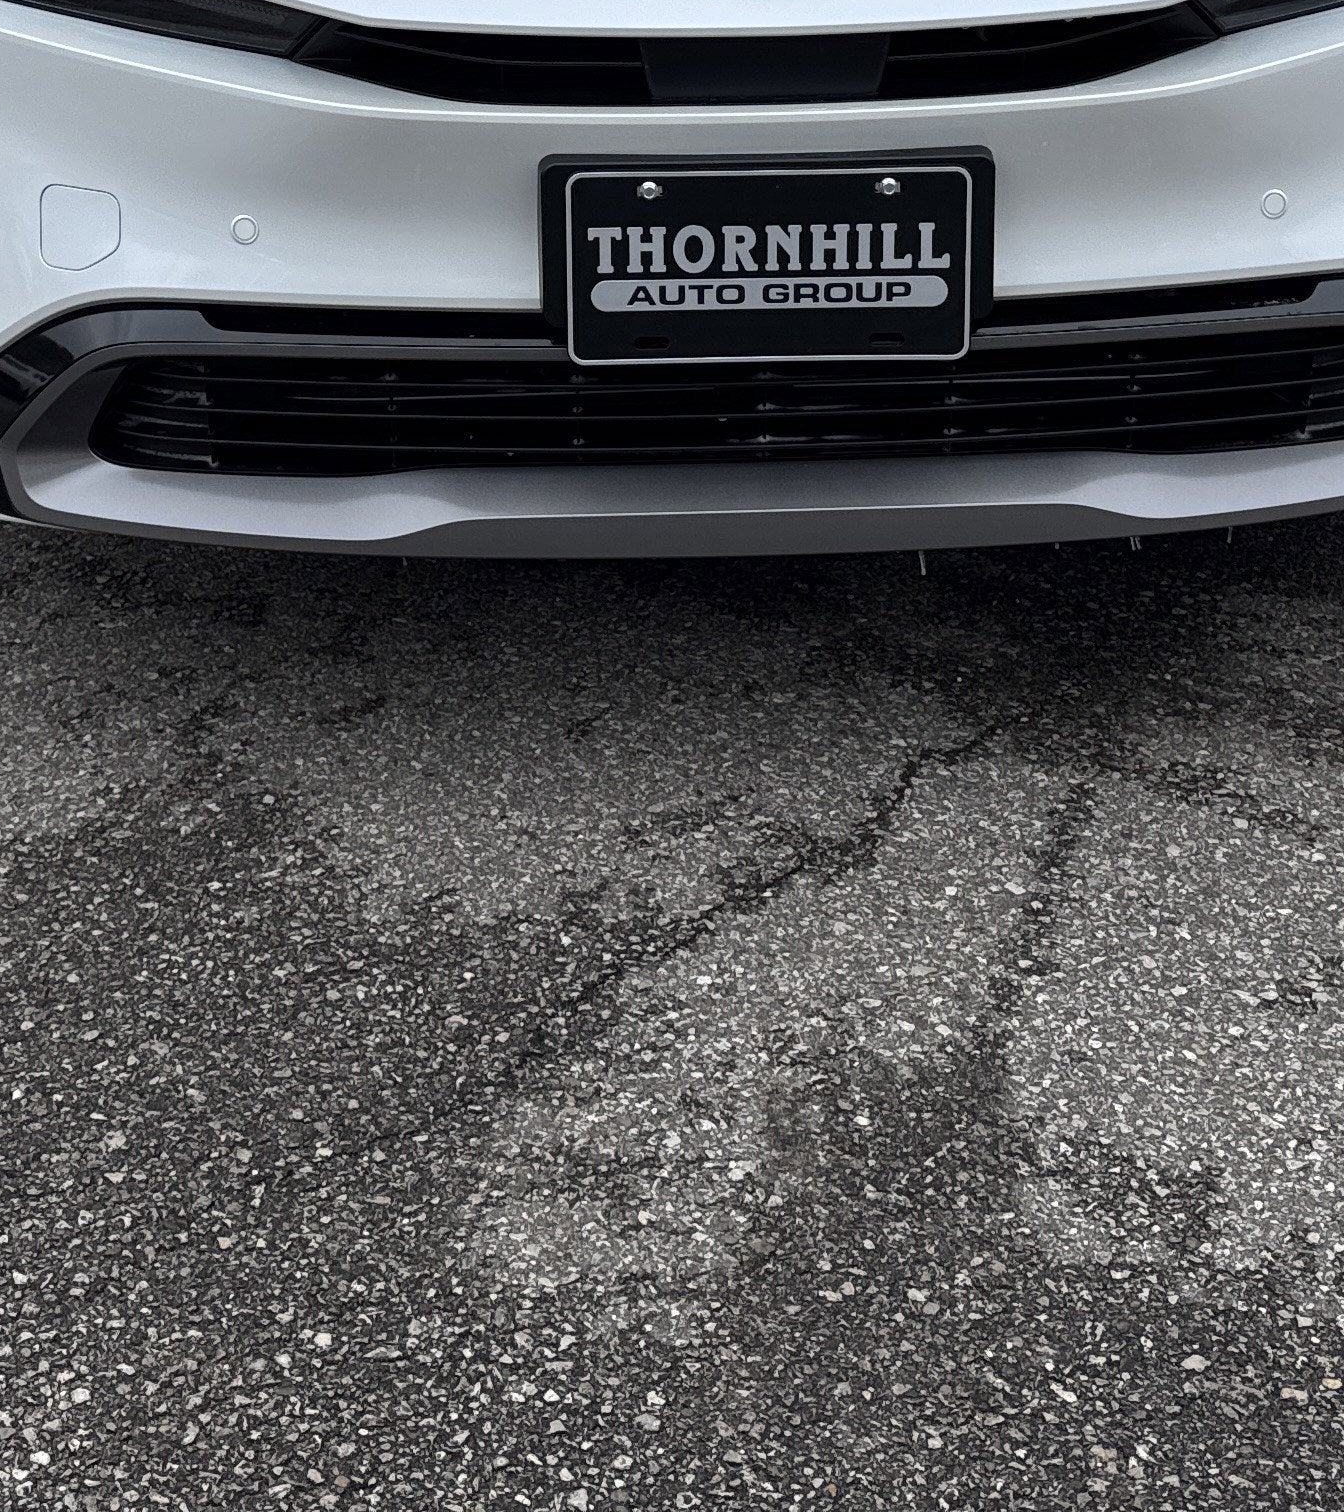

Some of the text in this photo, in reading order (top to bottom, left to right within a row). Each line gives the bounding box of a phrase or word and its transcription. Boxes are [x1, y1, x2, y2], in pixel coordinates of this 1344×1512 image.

[587, 222, 951, 274] THORNHILL
[626, 281, 912, 307] AUTO GROUP
